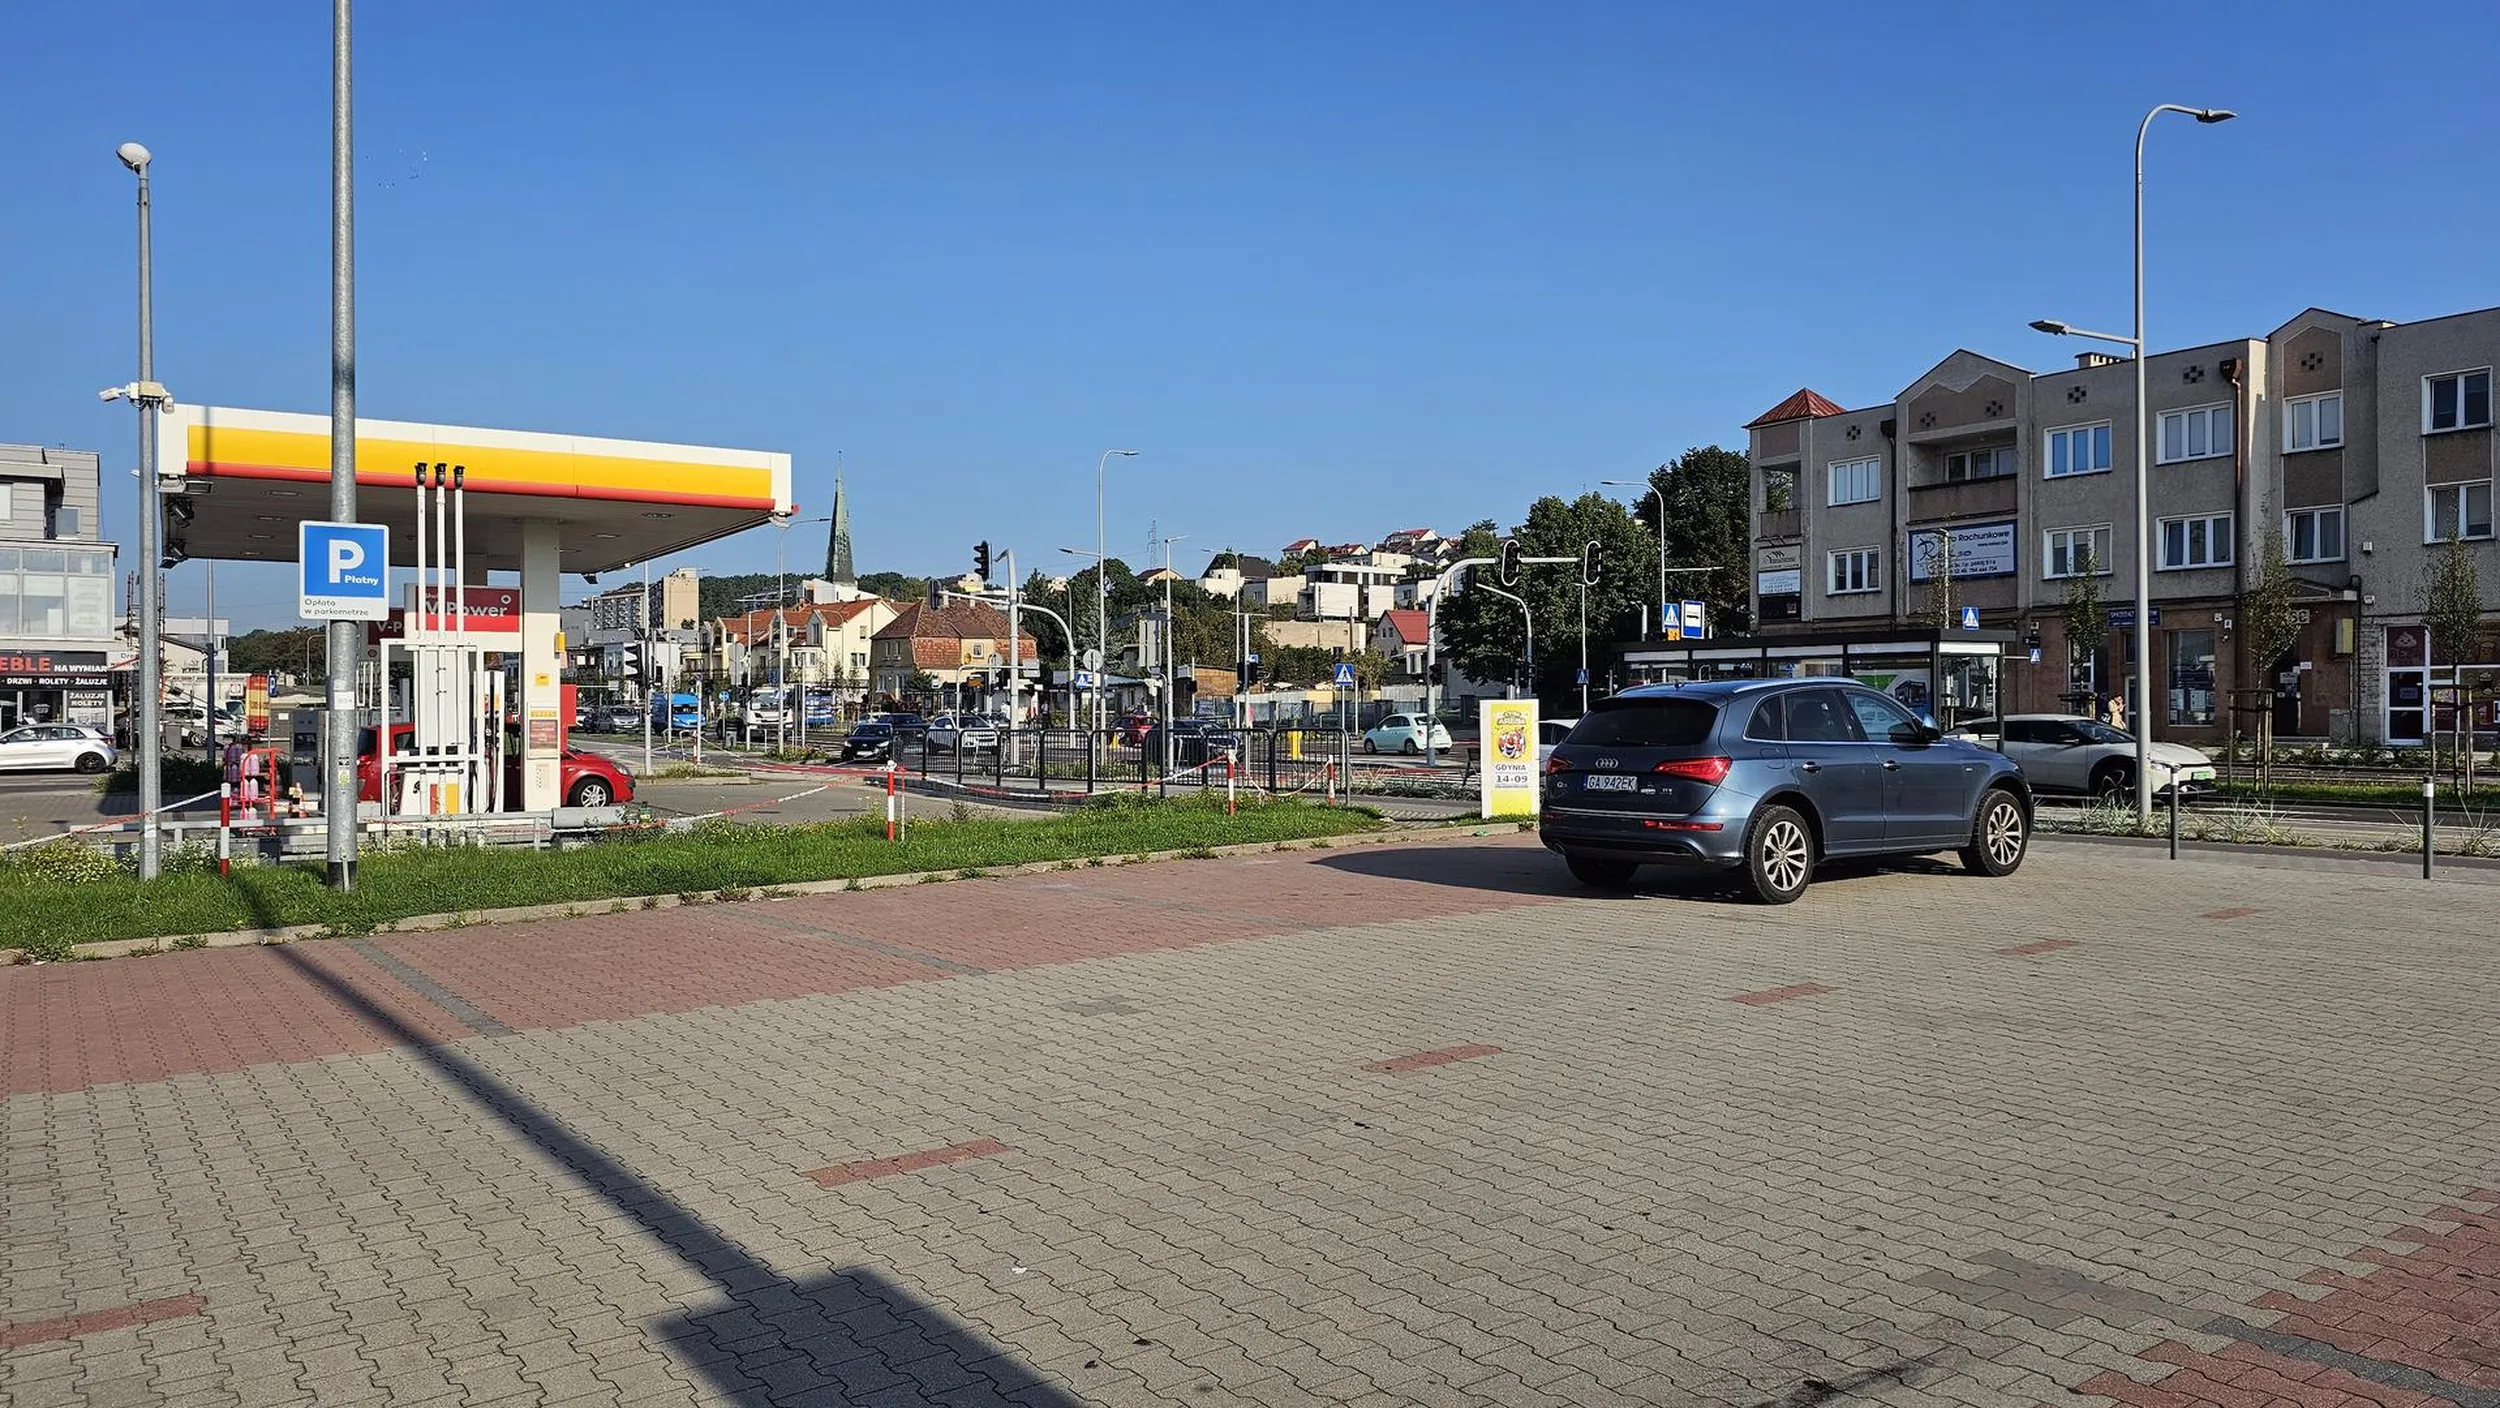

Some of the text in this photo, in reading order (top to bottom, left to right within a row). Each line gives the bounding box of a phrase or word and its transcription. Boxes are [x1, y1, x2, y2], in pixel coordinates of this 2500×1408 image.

[328, 539, 365, 584] P
[344, 574, 379, 586] Płatny
[304, 598, 336, 607] Opłata
[314, 608, 370, 616] parkometrze
[54, 664, 67, 672] NA
[69, 664, 108, 672] WYMIAR
[6, 676, 108, 686] DRZWI ROLETY ŻALUZJE
[69, 691, 106, 699] ŻALUZJE
[1495, 763, 1527, 771] GDYNIA
